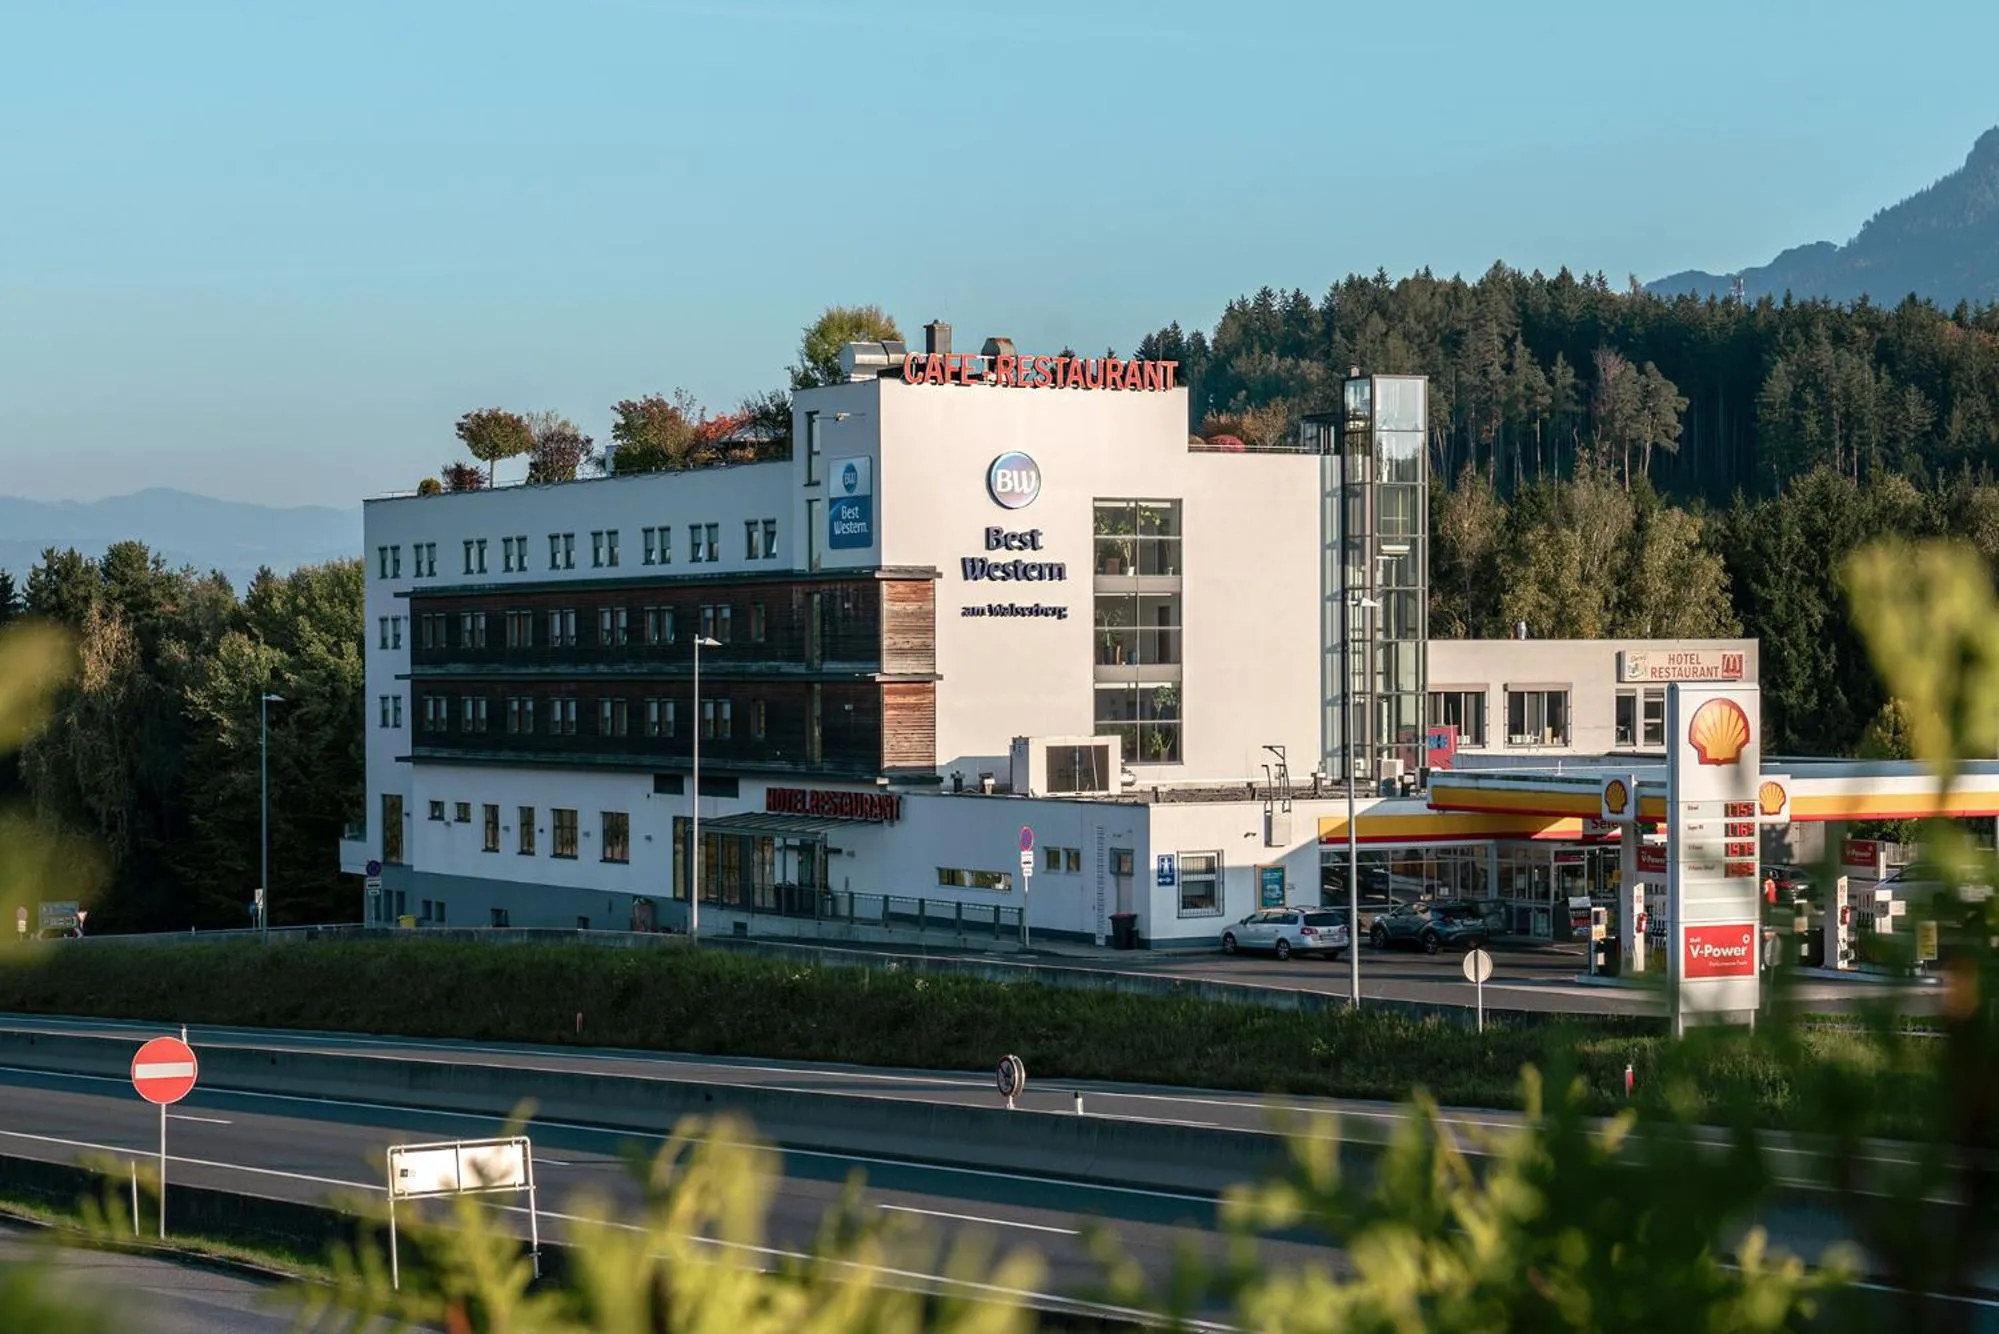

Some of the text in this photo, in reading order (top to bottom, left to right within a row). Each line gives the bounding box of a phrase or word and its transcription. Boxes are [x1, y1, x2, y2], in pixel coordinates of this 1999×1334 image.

[996, 354, 1179, 391] RESTAURANT
[996, 468, 1036, 494] BW
[841, 505, 860, 520] Best
[985, 525, 1044, 551] Best
[961, 556, 1067, 582] Western
[1650, 665, 1720, 679] RESTAURANT
[1668, 653, 1701, 666] HOTEL
[766, 787, 901, 821] HOTEL RESTAURANT
[1689, 944, 1748, 958] V-Power
